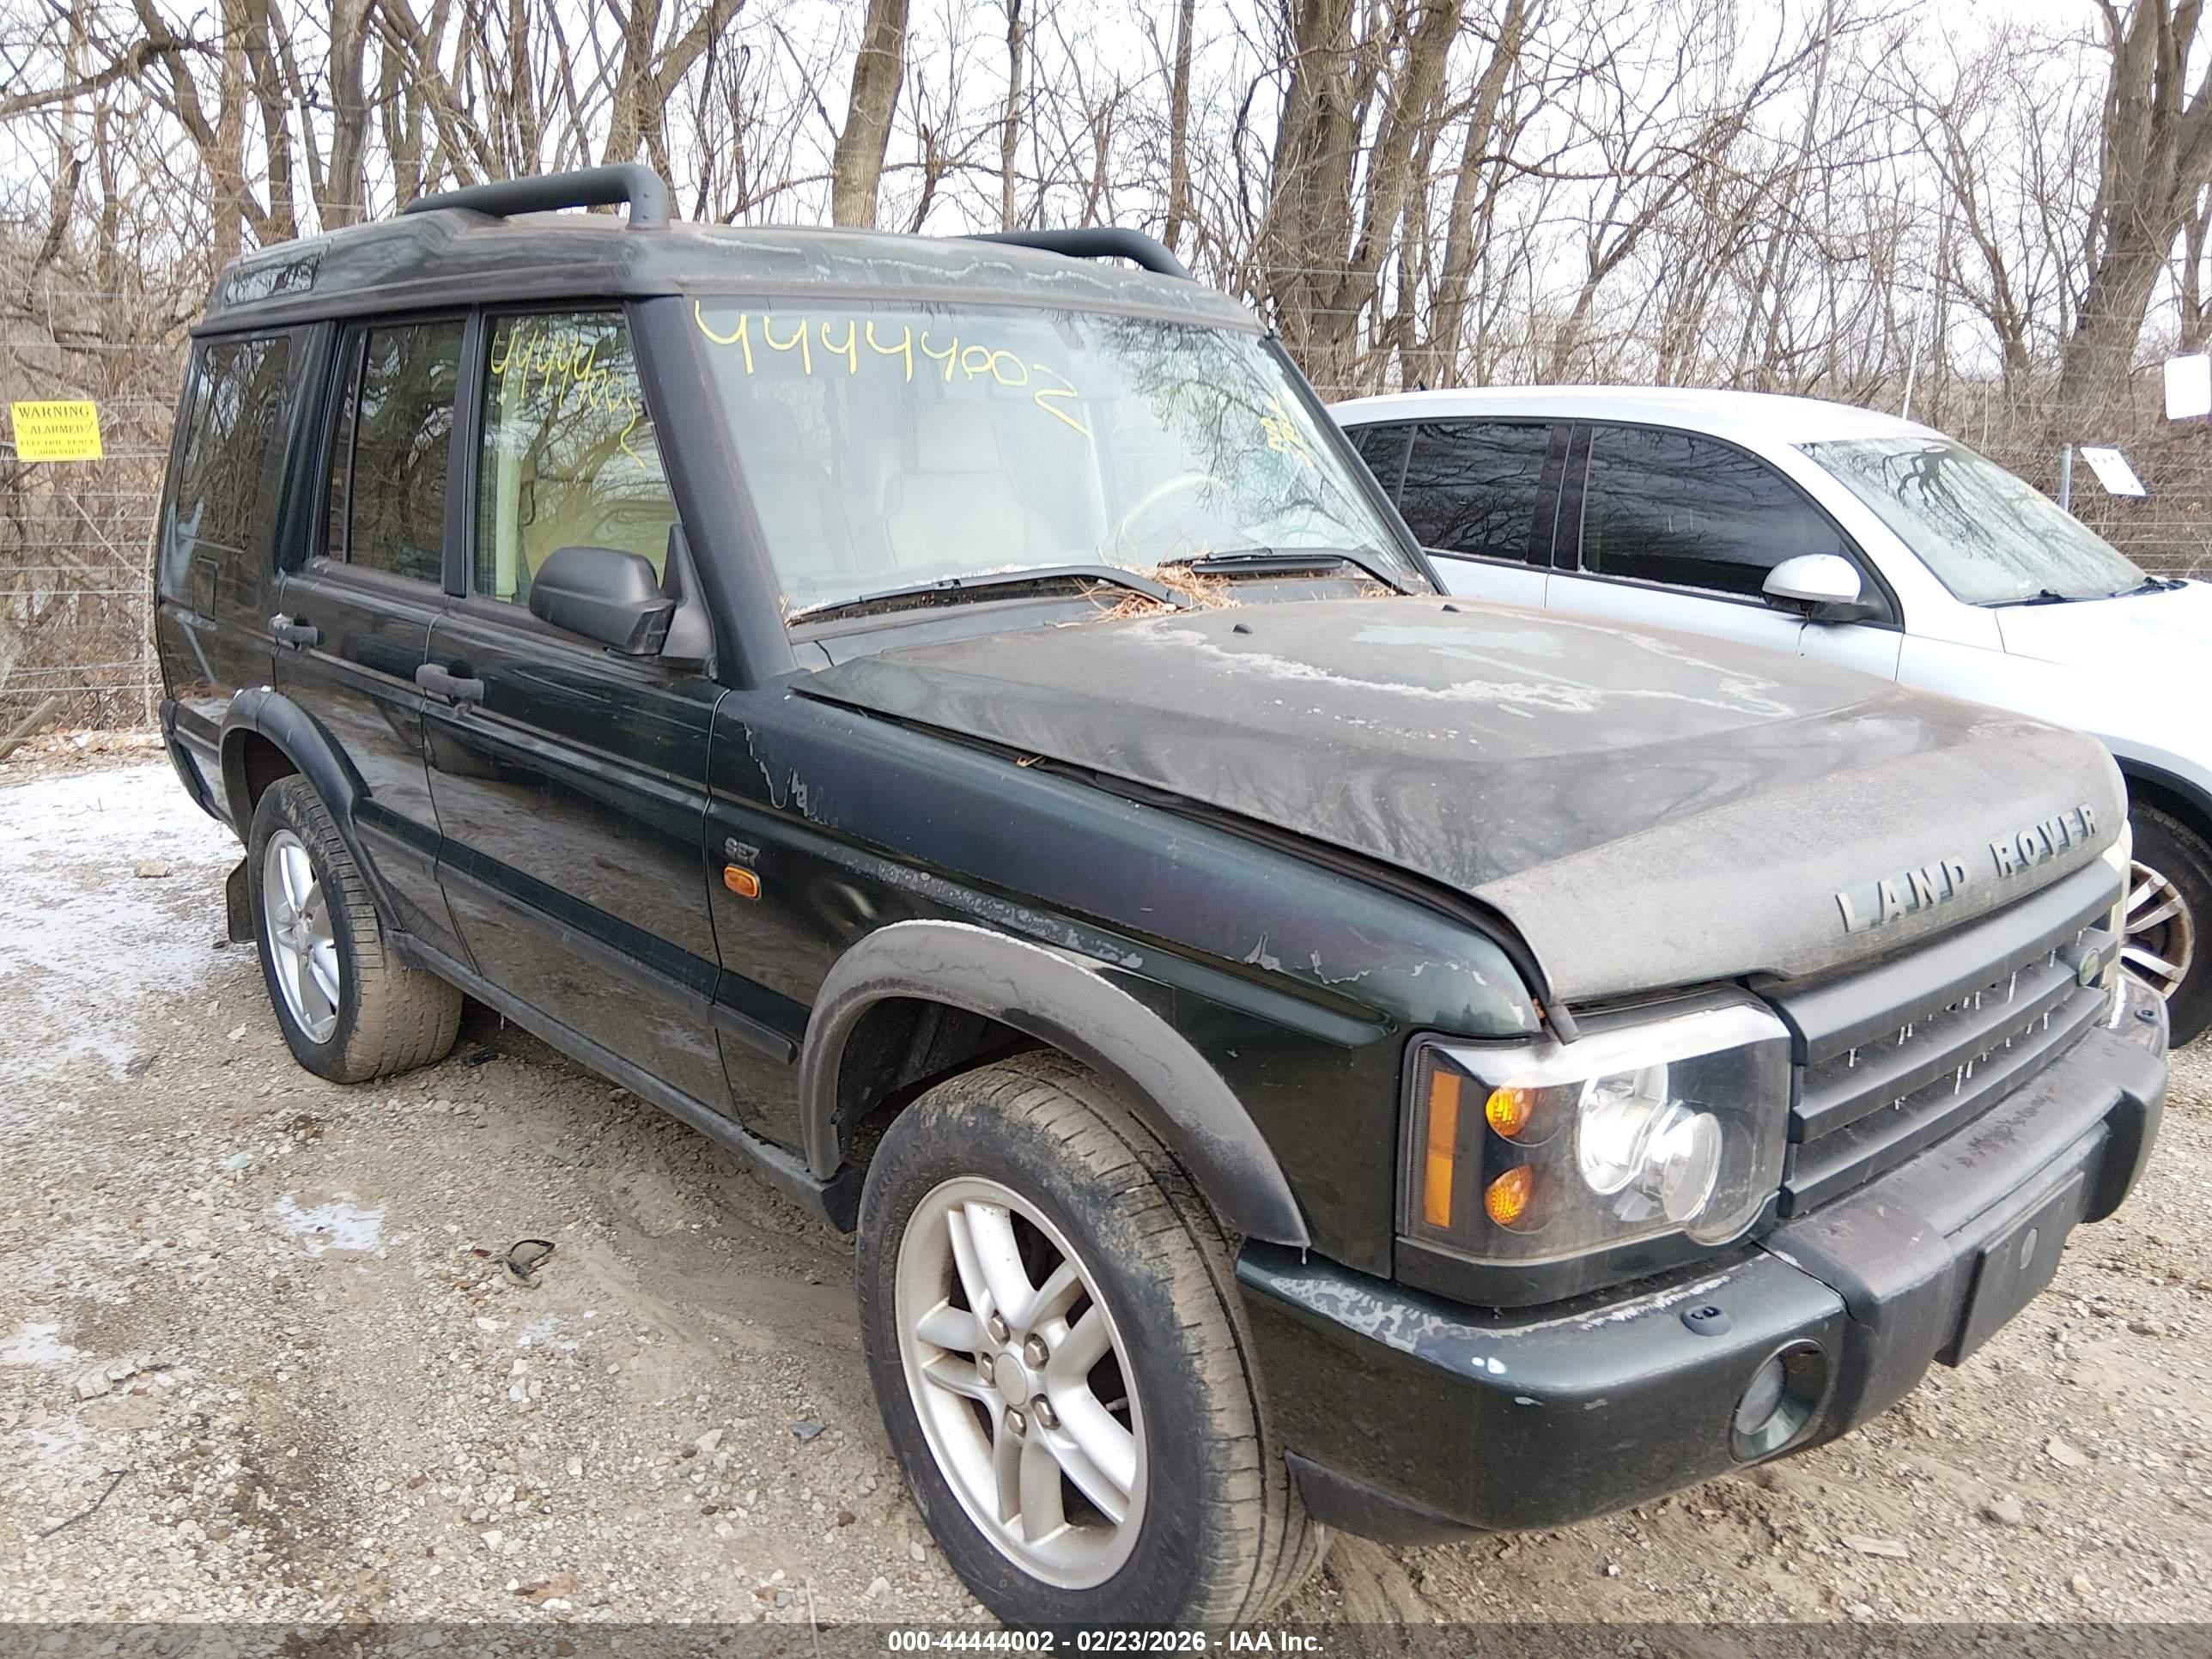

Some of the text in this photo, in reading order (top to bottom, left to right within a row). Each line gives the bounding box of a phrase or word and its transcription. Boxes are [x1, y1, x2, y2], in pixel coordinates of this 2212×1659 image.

[694, 300, 1095, 441] 44444002
[18, 405, 89, 419] WARNING
[30, 424, 83, 434] ALARMED
[1835, 803, 2097, 933] LAND ROVER
